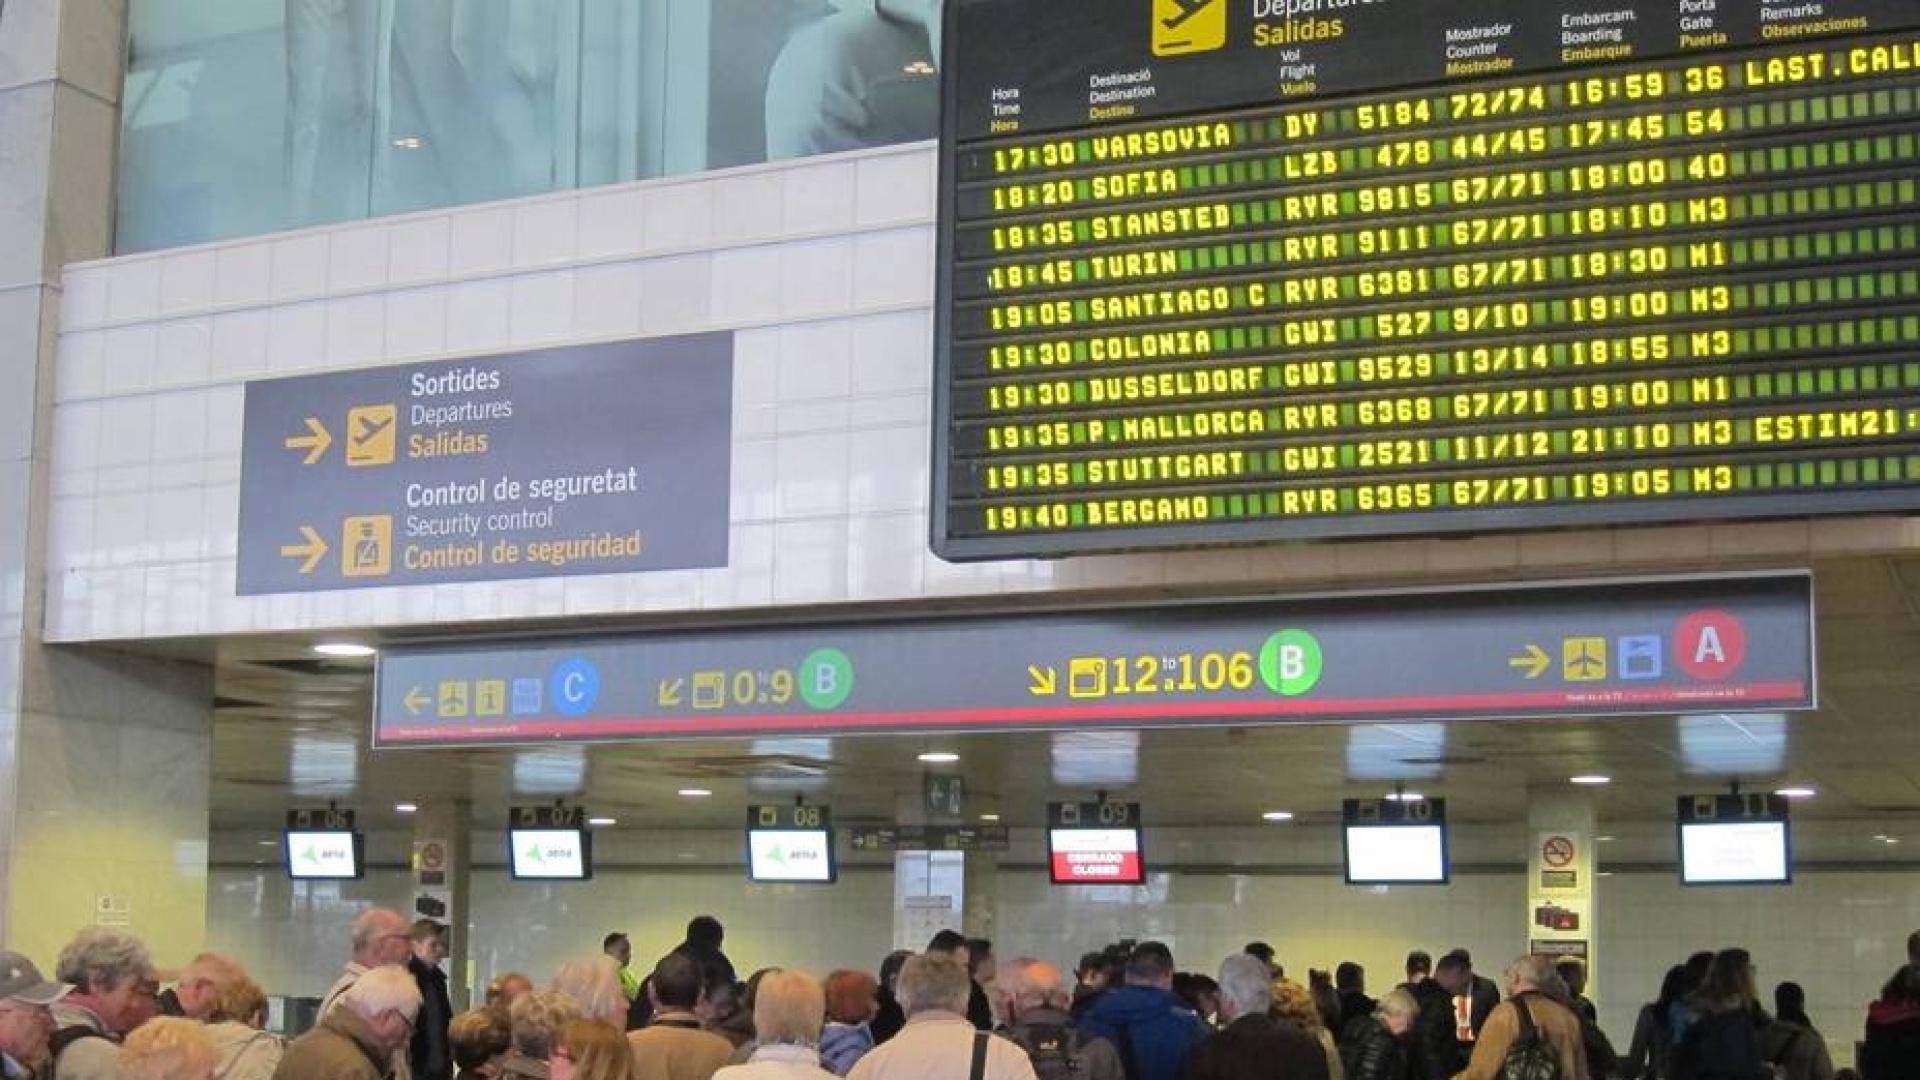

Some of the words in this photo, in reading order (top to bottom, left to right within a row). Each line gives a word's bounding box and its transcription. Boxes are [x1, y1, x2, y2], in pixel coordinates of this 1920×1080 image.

[1562, 10, 1636, 27] Embarcam.
[1680, 16, 1713, 31] Gate
[1761, 3, 1823, 21] Remarks
[1254, 18, 1344, 46] Salidas
[1446, 24, 1513, 42] Mostrador
[1562, 28, 1623, 45] Boarding
[1762, 16, 1867, 38] Observaciones
[1447, 43, 1498, 59] Counter
[1680, 33, 1727, 48] Puerta
[1280, 50, 1300, 62] Vol
[1562, 45, 1632, 62] Embarque
[1090, 69, 1151, 87] Destinació
[1280, 64, 1315, 80] Flight
[1446, 58, 1514, 75] Mostrador
[992, 88, 1019, 100] Hora
[1090, 86, 1156, 104] Destination
[1280, 81, 1317, 95] Vuelo
[992, 103, 1020, 116] Time
[995, 142, 1075, 171] 17:30
[1093, 123, 1230, 159] VARSOVIA
[1286, 113, 1317, 138] DY
[1358, 99, 1430, 129] 5184
[1451, 86, 1544, 119] 72/74
[1569, 72, 1663, 105] 16:59
[1685, 65, 1723, 92] 36
[1090, 105, 1135, 120] Destino
[990, 120, 1019, 133] Hora
[994, 181, 1074, 210] 18:20
[1092, 169, 1176, 199] SOFIA
[1285, 150, 1337, 178] LZB
[1377, 140, 1430, 167] 478
[1452, 127, 1545, 159] 44/45
[1569, 115, 1664, 148] 17:45
[1687, 108, 1723, 135] 54
[994, 221, 1073, 250] 18:35
[1092, 204, 1230, 239] STANSTED
[1286, 193, 1338, 220] RYR
[1358, 183, 1431, 212] 9815
[1452, 171, 1543, 203] 67/71
[1570, 159, 1665, 191] 18:00
[1689, 152, 1725, 179] 40
[992, 260, 1073, 289] 18:45
[1091, 250, 1176, 279] TURIN
[1285, 235, 1338, 261] RYR
[1358, 225, 1428, 254] 9111
[1453, 214, 1543, 245] 67/71
[1571, 202, 1666, 234] 18:10
[1689, 197, 1727, 222] M3
[992, 301, 1073, 330] 19:05
[1091, 287, 1228, 320] SANTIAGO
[1249, 284, 1265, 307] C
[1284, 276, 1338, 303] RYR
[1358, 268, 1428, 297] 6381
[1453, 258, 1544, 288] 67/71
[1571, 247, 1667, 278] 18:30
[1690, 241, 1724, 268] M1
[990, 341, 1071, 369] 19:30
[1090, 330, 1211, 361] COLONIA
[1284, 319, 1336, 345] GWI
[1377, 311, 1431, 338] 527
[1453, 303, 1528, 332] 9/10
[1572, 291, 1667, 322] 19:00
[1691, 286, 1729, 312] M3
[411, 367, 500, 397] Sortides
[990, 382, 1071, 409] 19:30
[1089, 367, 1263, 402] DUSSELDORF
[1284, 361, 1336, 386] GWI
[1358, 353, 1431, 382] 9529
[1455, 344, 1547, 374] 13/14
[1572, 334, 1668, 365] 18:55
[1692, 330, 1729, 357] M3
[411, 397, 512, 427] Departures
[988, 423, 1070, 450] 19:35
[1089, 409, 1263, 442] P.MALLORCA
[1284, 404, 1337, 430] RYR
[1358, 397, 1431, 425] 6368
[1454, 390, 1545, 418] 67/71
[1573, 380, 1669, 410] 19:00
[1693, 376, 1727, 402] M1
[408, 430, 489, 460] Salidas
[988, 462, 1069, 489] 19:35
[1088, 452, 1242, 483] STUTTGART
[1284, 446, 1336, 471] GWI
[1358, 440, 1428, 466] 2521
[1455, 431, 1549, 460] 11/12
[1572, 423, 1670, 452] 21:10
[1693, 419, 1731, 446] M3
[407, 478, 485, 508] Control
[494, 476, 521, 502] de
[529, 466, 638, 502] seguretat
[986, 504, 1068, 530] 19:40
[1087, 496, 1208, 525] BERGAMO
[1284, 489, 1337, 514] RYR
[1358, 483, 1431, 510] 6365
[1453, 477, 1545, 504] 67/71
[1573, 469, 1670, 498] 19:05
[1694, 466, 1731, 491] M3
[406, 510, 481, 538] Security
[488, 506, 554, 531] control
[404, 540, 483, 570] Control
[493, 539, 519, 565] de
[528, 529, 641, 567] seguridad
[1694, 625, 1726, 664] A
[815, 664, 837, 695] B
[1111, 656, 1159, 693] 12
[1177, 652, 1254, 691] 106
[1280, 644, 1305, 680] B
[564, 672, 585, 703] C
[793, 806, 820, 827] 08
[1100, 802, 1128, 824] 09
